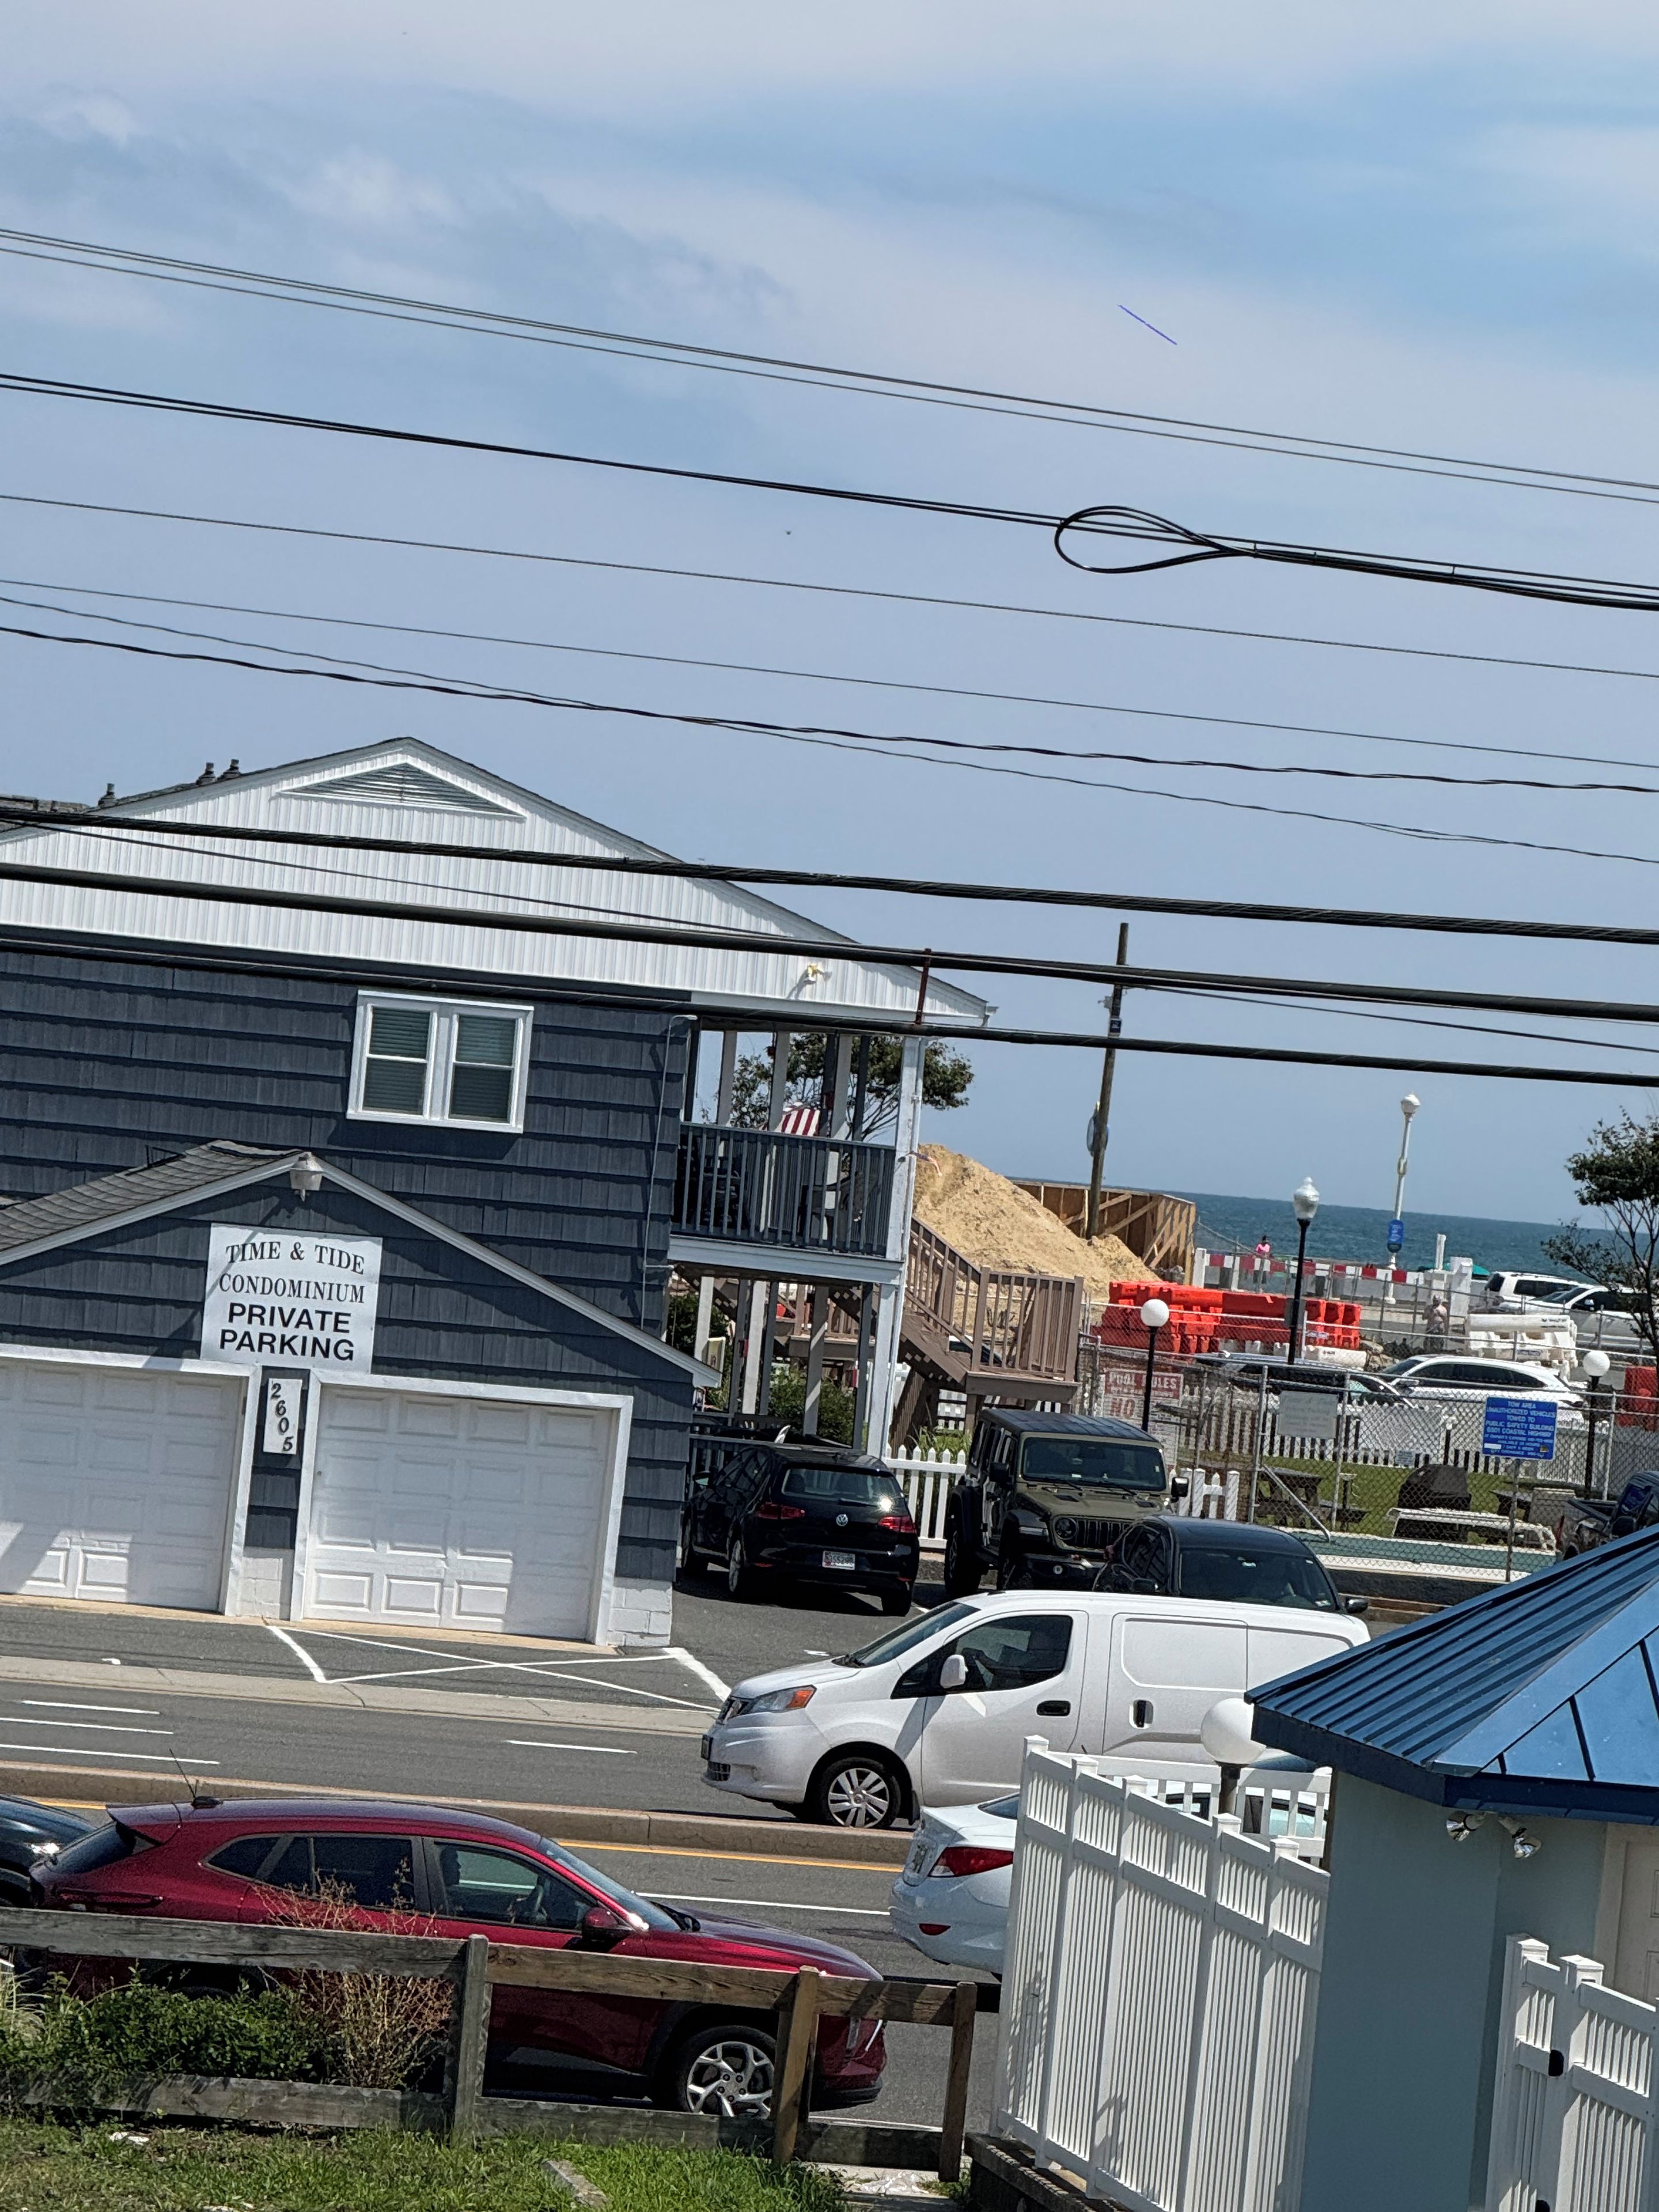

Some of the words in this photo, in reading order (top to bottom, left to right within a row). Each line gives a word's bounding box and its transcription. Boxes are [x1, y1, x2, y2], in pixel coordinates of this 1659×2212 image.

[226, 1241, 281, 1265] TIME
[290, 1241, 305, 1260] &
[315, 1244, 365, 1275] TIDE
[219, 1272, 365, 1304] CONDOMINIUM
[228, 1302, 351, 1334] PRIVATE
[219, 1328, 354, 1361] PARKING
[271, 1382, 293, 1452] 2605
[1487, 1407, 1528, 1415] UNAUTHORIZED
